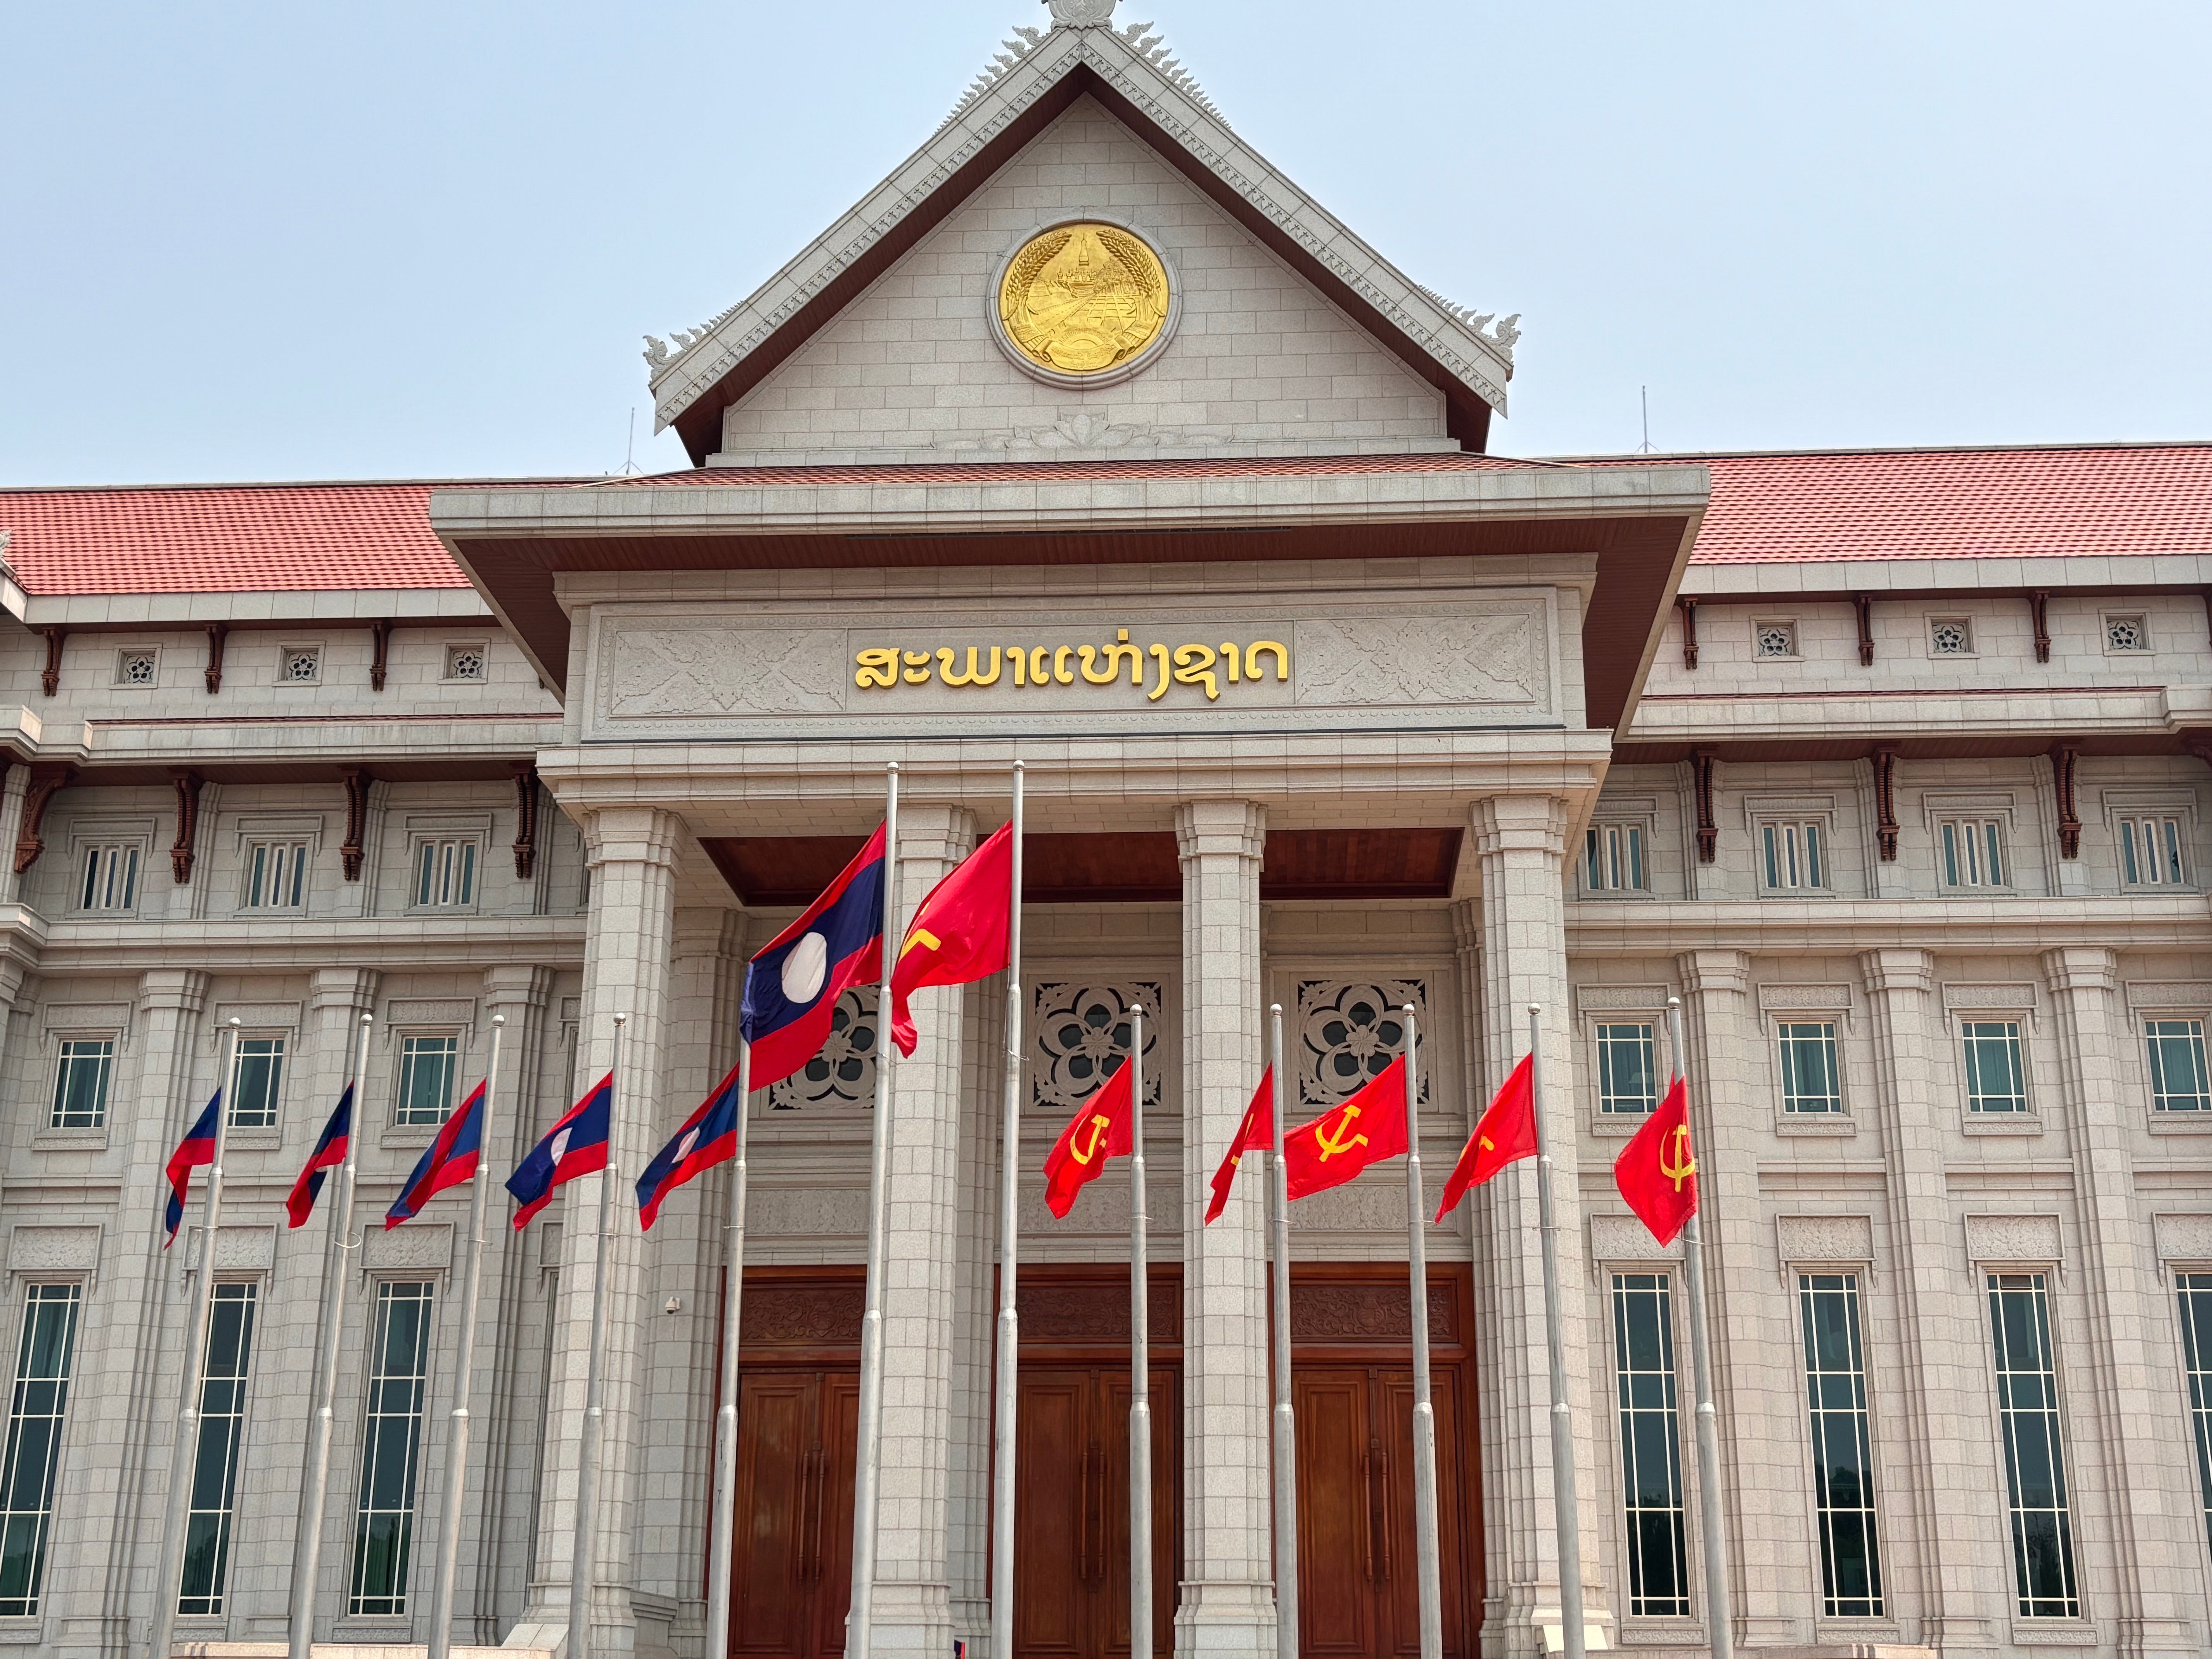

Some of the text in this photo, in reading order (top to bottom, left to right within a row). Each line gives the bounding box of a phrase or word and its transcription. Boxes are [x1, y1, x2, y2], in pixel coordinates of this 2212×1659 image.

[855, 628, 1288, 702] ສະພາແຫ່ງຊາດ
